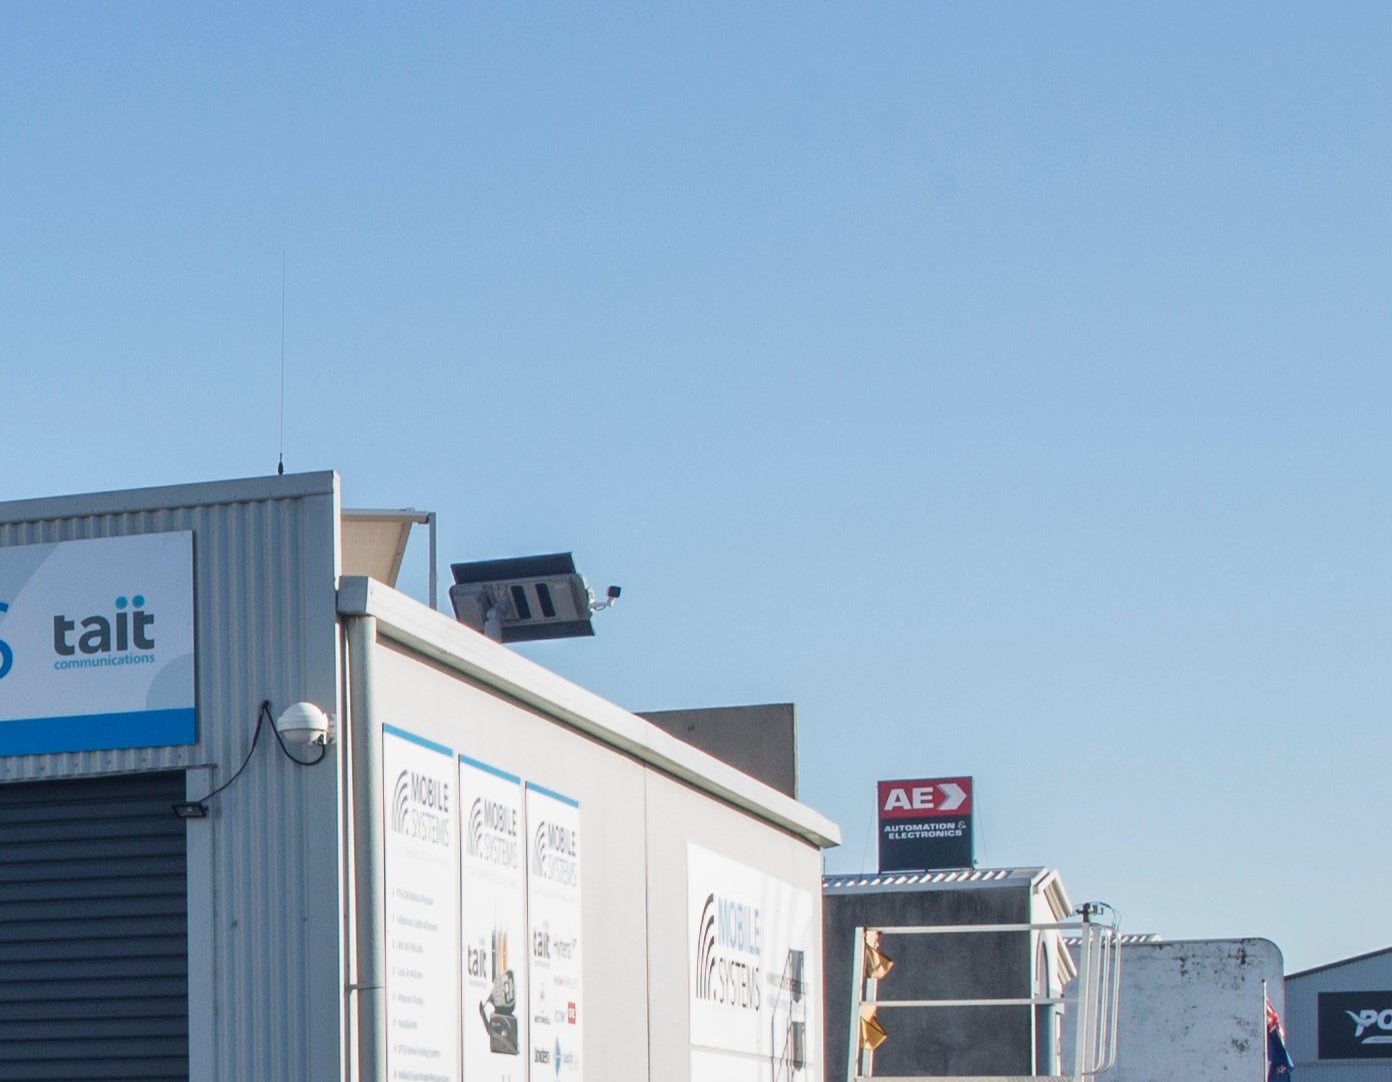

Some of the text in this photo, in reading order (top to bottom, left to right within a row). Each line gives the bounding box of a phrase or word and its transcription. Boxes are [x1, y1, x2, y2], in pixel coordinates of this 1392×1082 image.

[53, 594, 155, 657] tait
[54, 652, 156, 672] communications
[411, 772, 449, 813] MOBILE
[884, 787, 934, 811] AE
[484, 798, 517, 837] MOBILE
[884, 820, 966, 832] AUTOMATION &
[888, 830, 962, 839] ELECTRONICS
[548, 822, 576, 857] MOBILE
[718, 897, 760, 955] MOBILE
